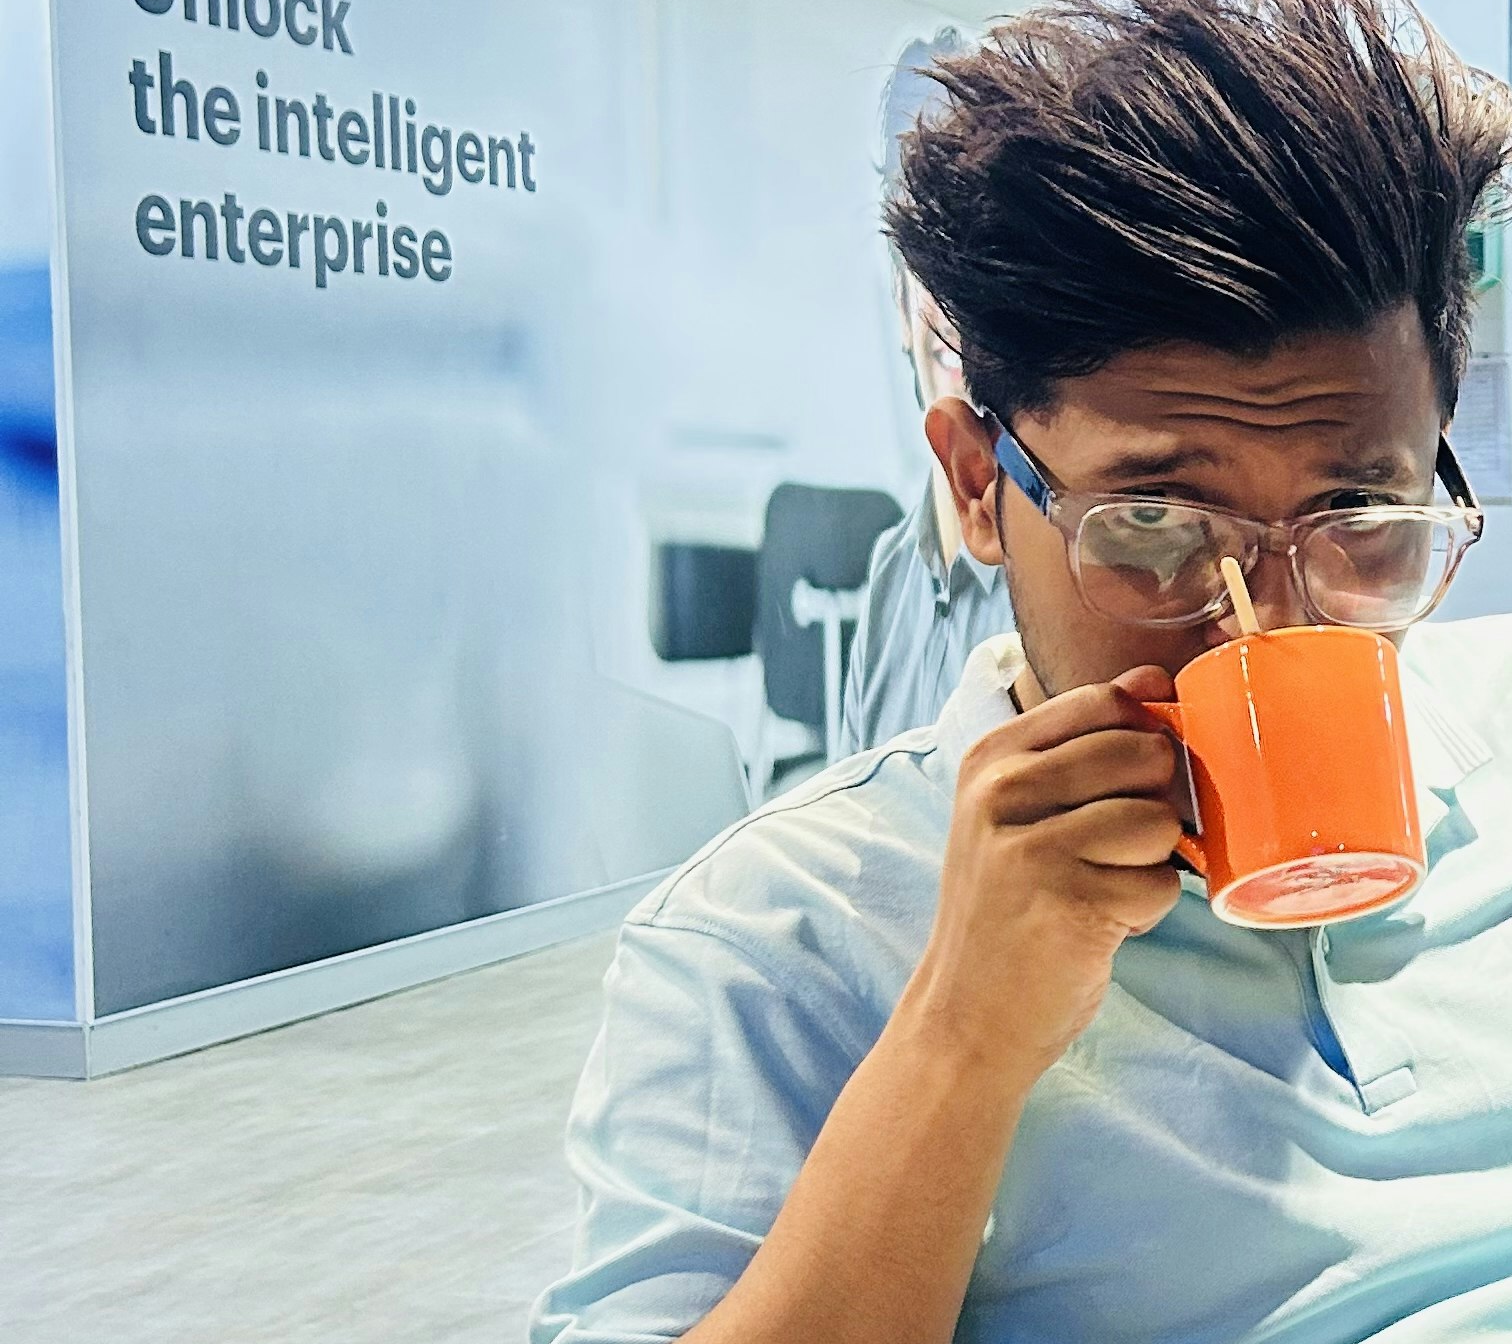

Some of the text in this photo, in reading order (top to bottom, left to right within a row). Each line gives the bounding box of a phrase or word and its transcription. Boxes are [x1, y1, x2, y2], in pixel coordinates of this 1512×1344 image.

[128, 51, 537, 196] the intelligent
[136, 193, 453, 289] enterprise
